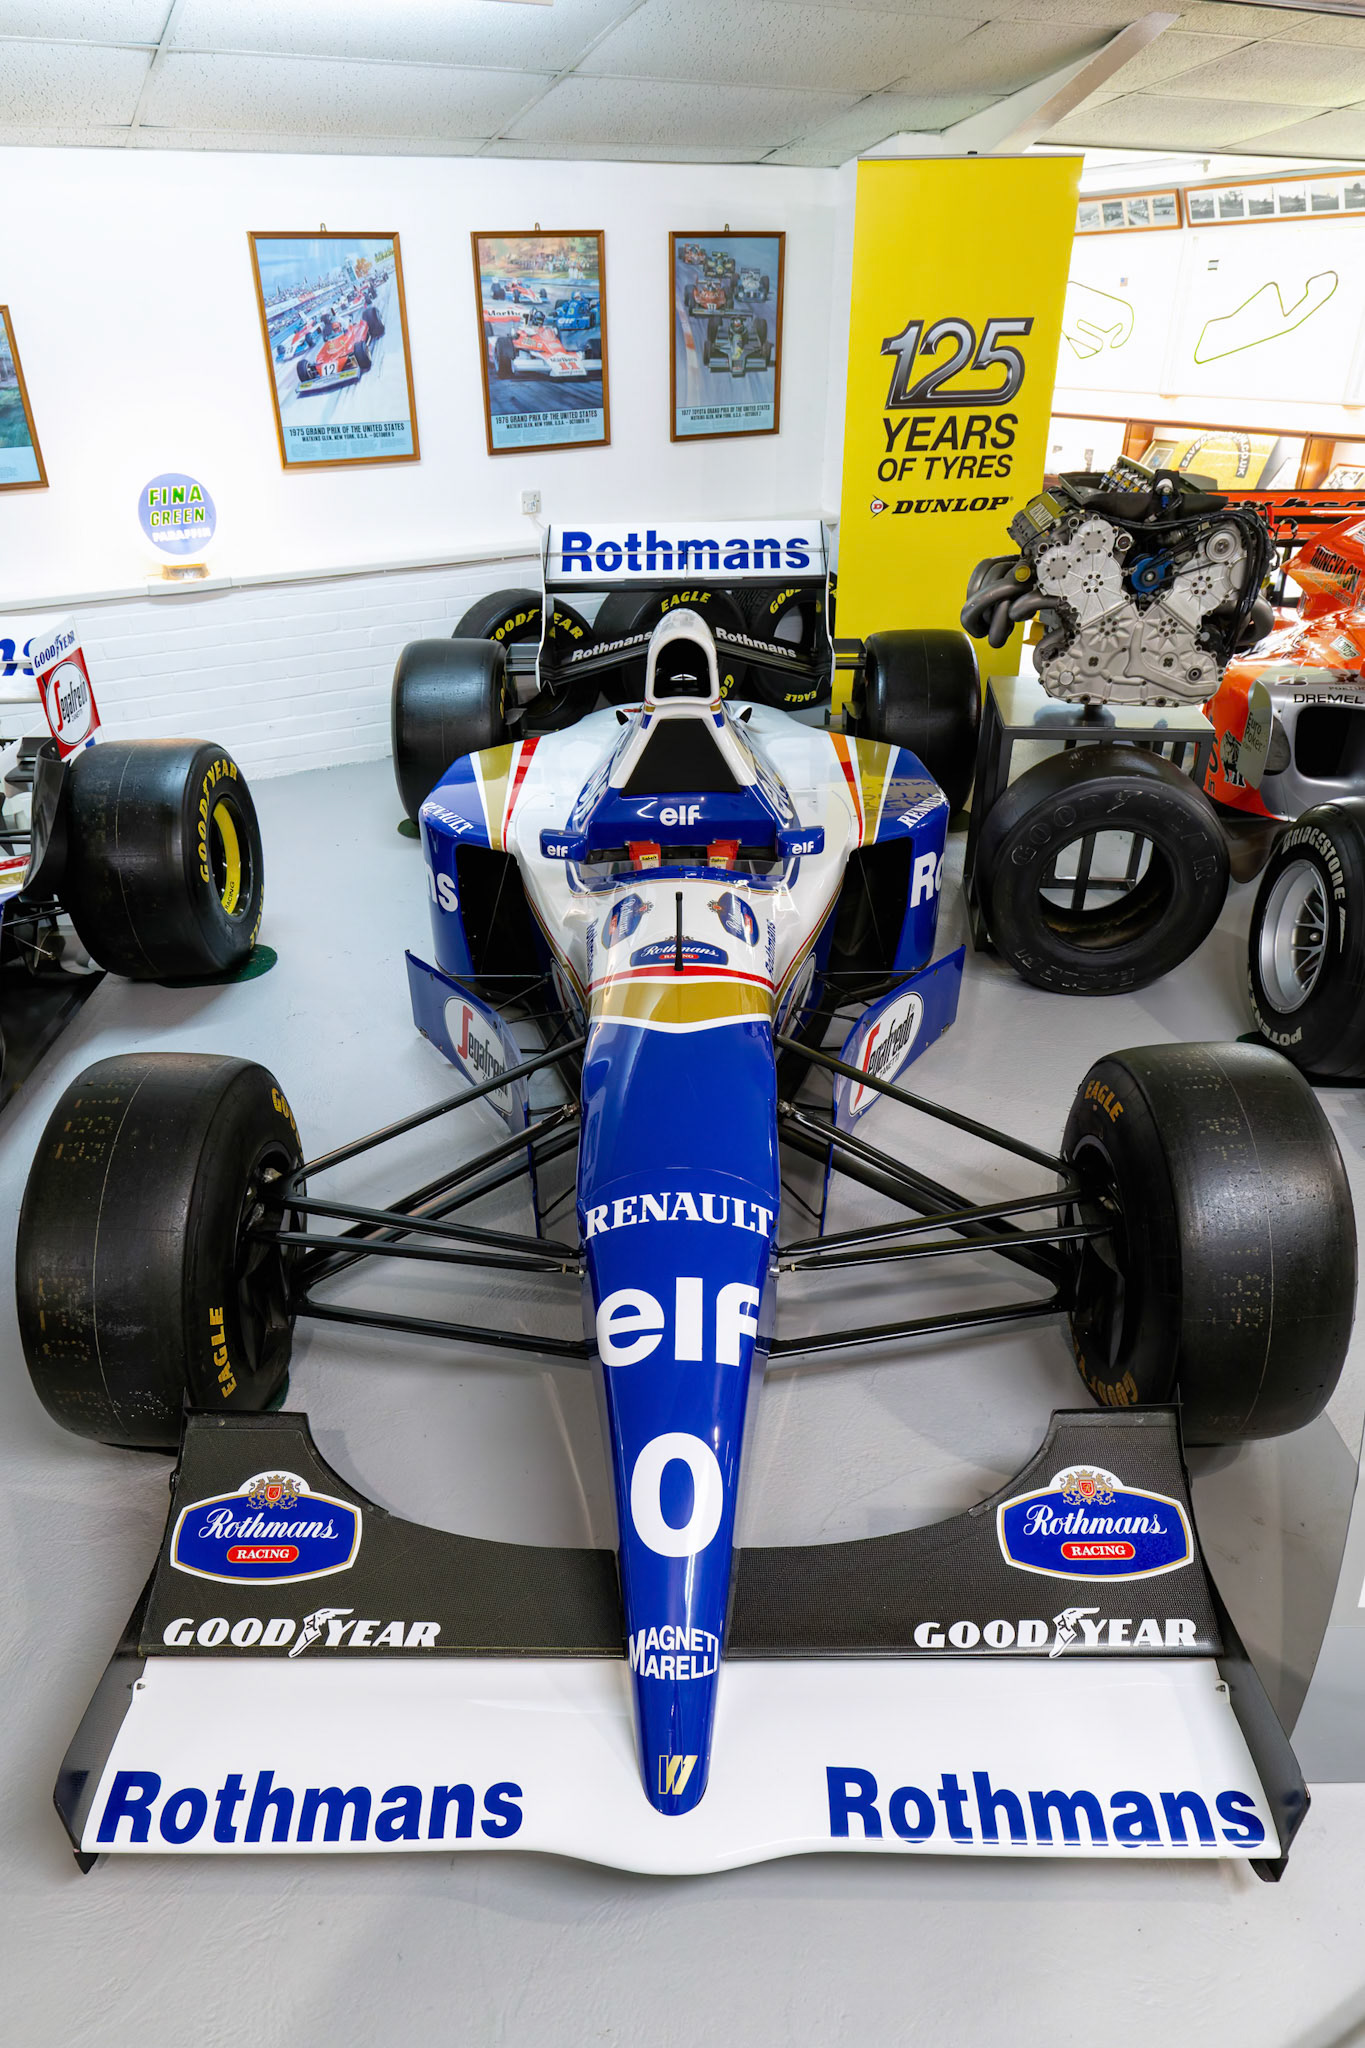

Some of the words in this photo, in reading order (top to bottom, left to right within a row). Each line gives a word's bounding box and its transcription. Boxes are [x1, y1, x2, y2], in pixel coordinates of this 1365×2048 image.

[323, 363, 336, 375] 12
[880, 317, 1034, 410] 125
[289, 428, 304, 437] 1975
[305, 427, 326, 436] GRAND
[327, 426, 341, 435] PRIX
[342, 425, 349, 434] OF
[351, 425, 361, 433] THE
[362, 424, 382, 432] UNITED
[384, 422, 405, 431] STATES
[510, 415, 527, 423] GRAND
[529, 414, 540, 422] PRIX
[549, 412, 559, 420] THE
[560, 411, 578, 419] UNITED
[579, 410, 598, 418] STATES
[882, 413, 1019, 453] YEARS
[877, 457, 916, 482] OF
[924, 454, 1013, 480] TYRES
[149, 484, 204, 506] FINA
[892, 496, 1010, 515] DUNLOP
[150, 507, 206, 527] GREEN
[562, 530, 810, 572] Rothmans
[660, 590, 711, 614] EAGLE
[571, 630, 653, 663] Rothmans
[715, 626, 797, 658] Rothmans
[784, 690, 817, 702] EAGLE
[1293, 694, 1364, 704] DREMEL
[659, 805, 701, 826] elf
[547, 844, 568, 857] elf
[791, 841, 815, 855] elf
[1281, 825, 1346, 900] BRIDGESTONE
[224, 881, 235, 910] RACING
[1085, 1079, 1124, 1122] EAGLE
[585, 1192, 774, 1240] RENAULT
[596, 1277, 759, 1367] elf
[209, 1306, 237, 1398] EAGLE
[630, 1432, 723, 1558] 0
[198, 1508, 340, 1540] Rothmans
[1023, 1504, 1168, 1536] Rothmans
[236, 1548, 290, 1560] RACING
[1071, 1545, 1126, 1557] RACING
[629, 1625, 719, 1662] MAGNETI
[629, 1645, 719, 1680] MARELLI
[96, 1770, 524, 1844] Rothmans
[826, 1766, 1266, 1848] Rothmans
